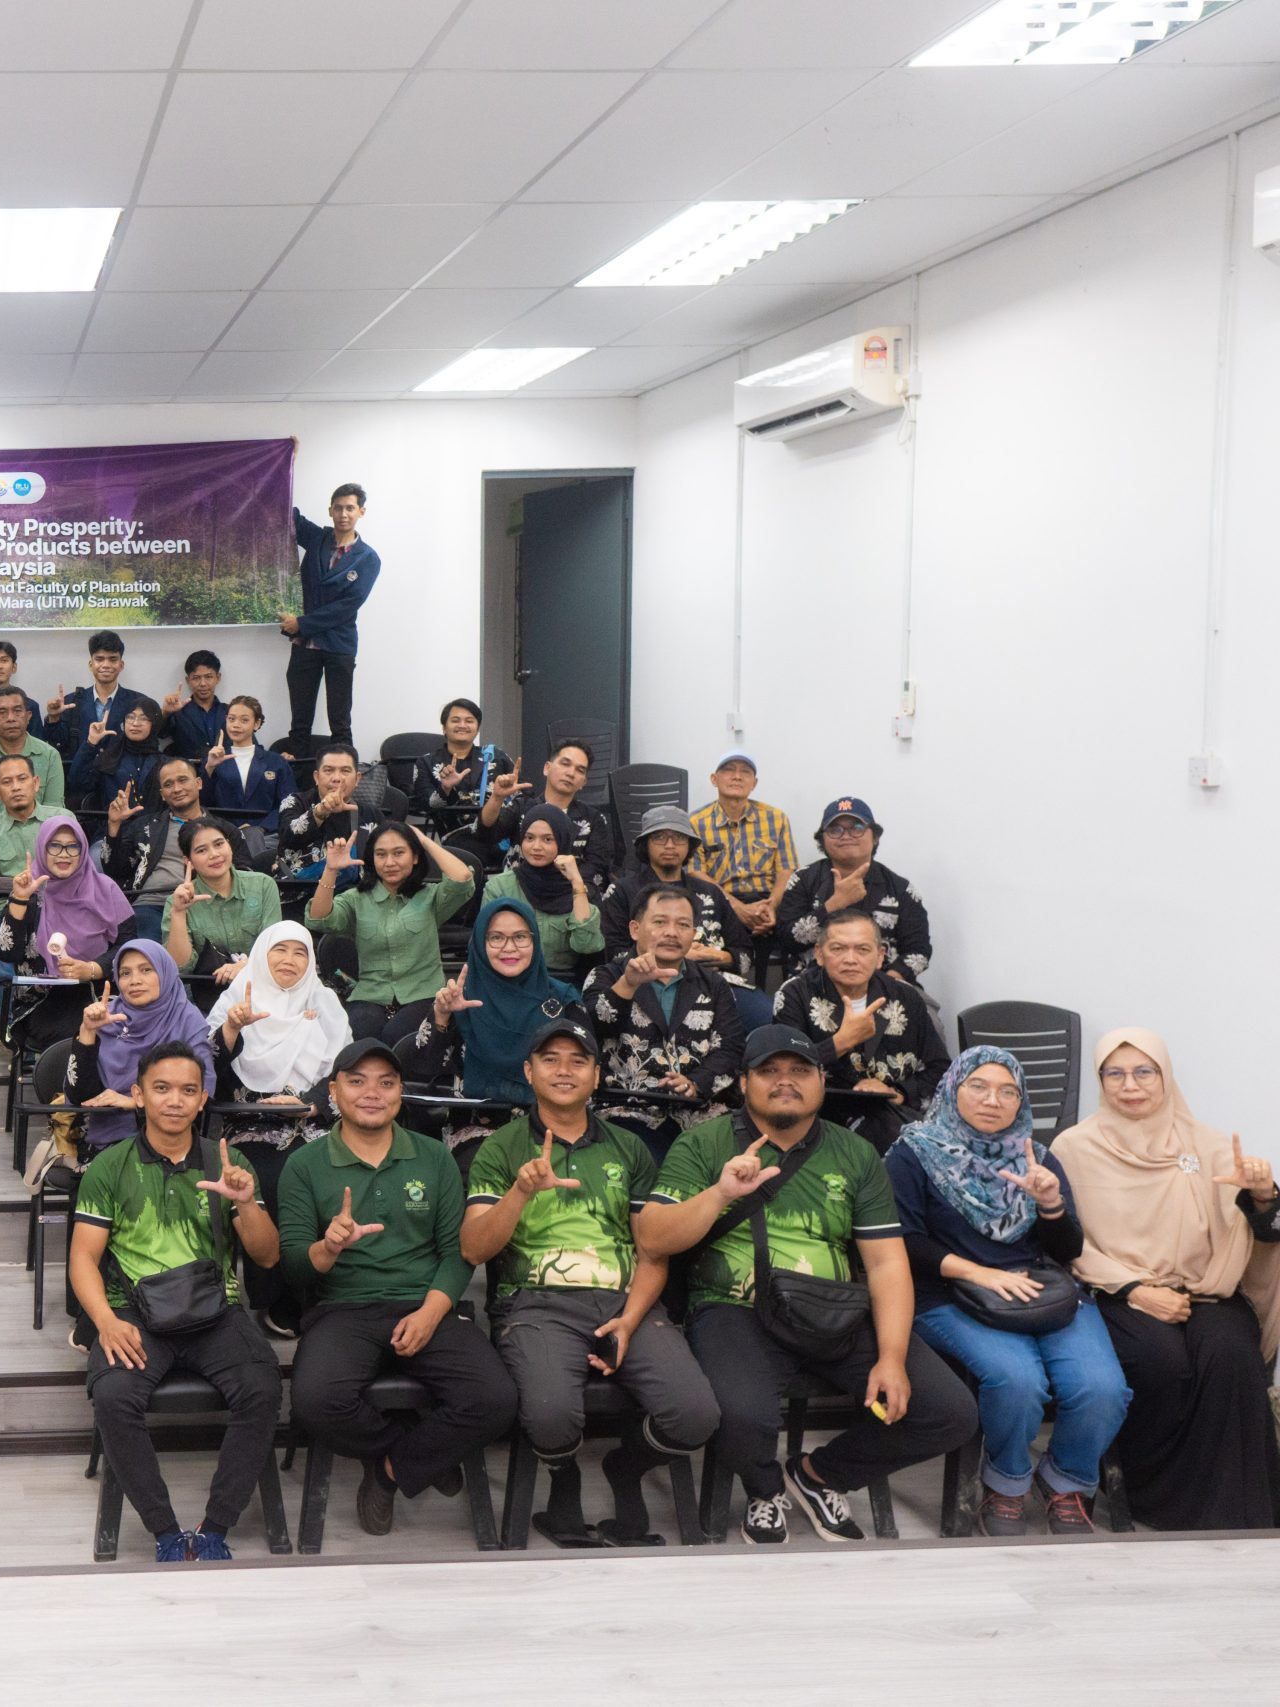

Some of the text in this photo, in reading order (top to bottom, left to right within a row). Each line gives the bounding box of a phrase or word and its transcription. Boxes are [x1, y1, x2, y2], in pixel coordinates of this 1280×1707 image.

[24, 517, 144, 540] Prosperity:
[96, 536, 191, 555] between
[17, 582, 69, 596] Faculty
[72, 581, 88, 593] of
[89, 580, 161, 593] Plantation
[36, 595, 84, 609] (UiTM)
[87, 595, 149, 608] Sarawak
